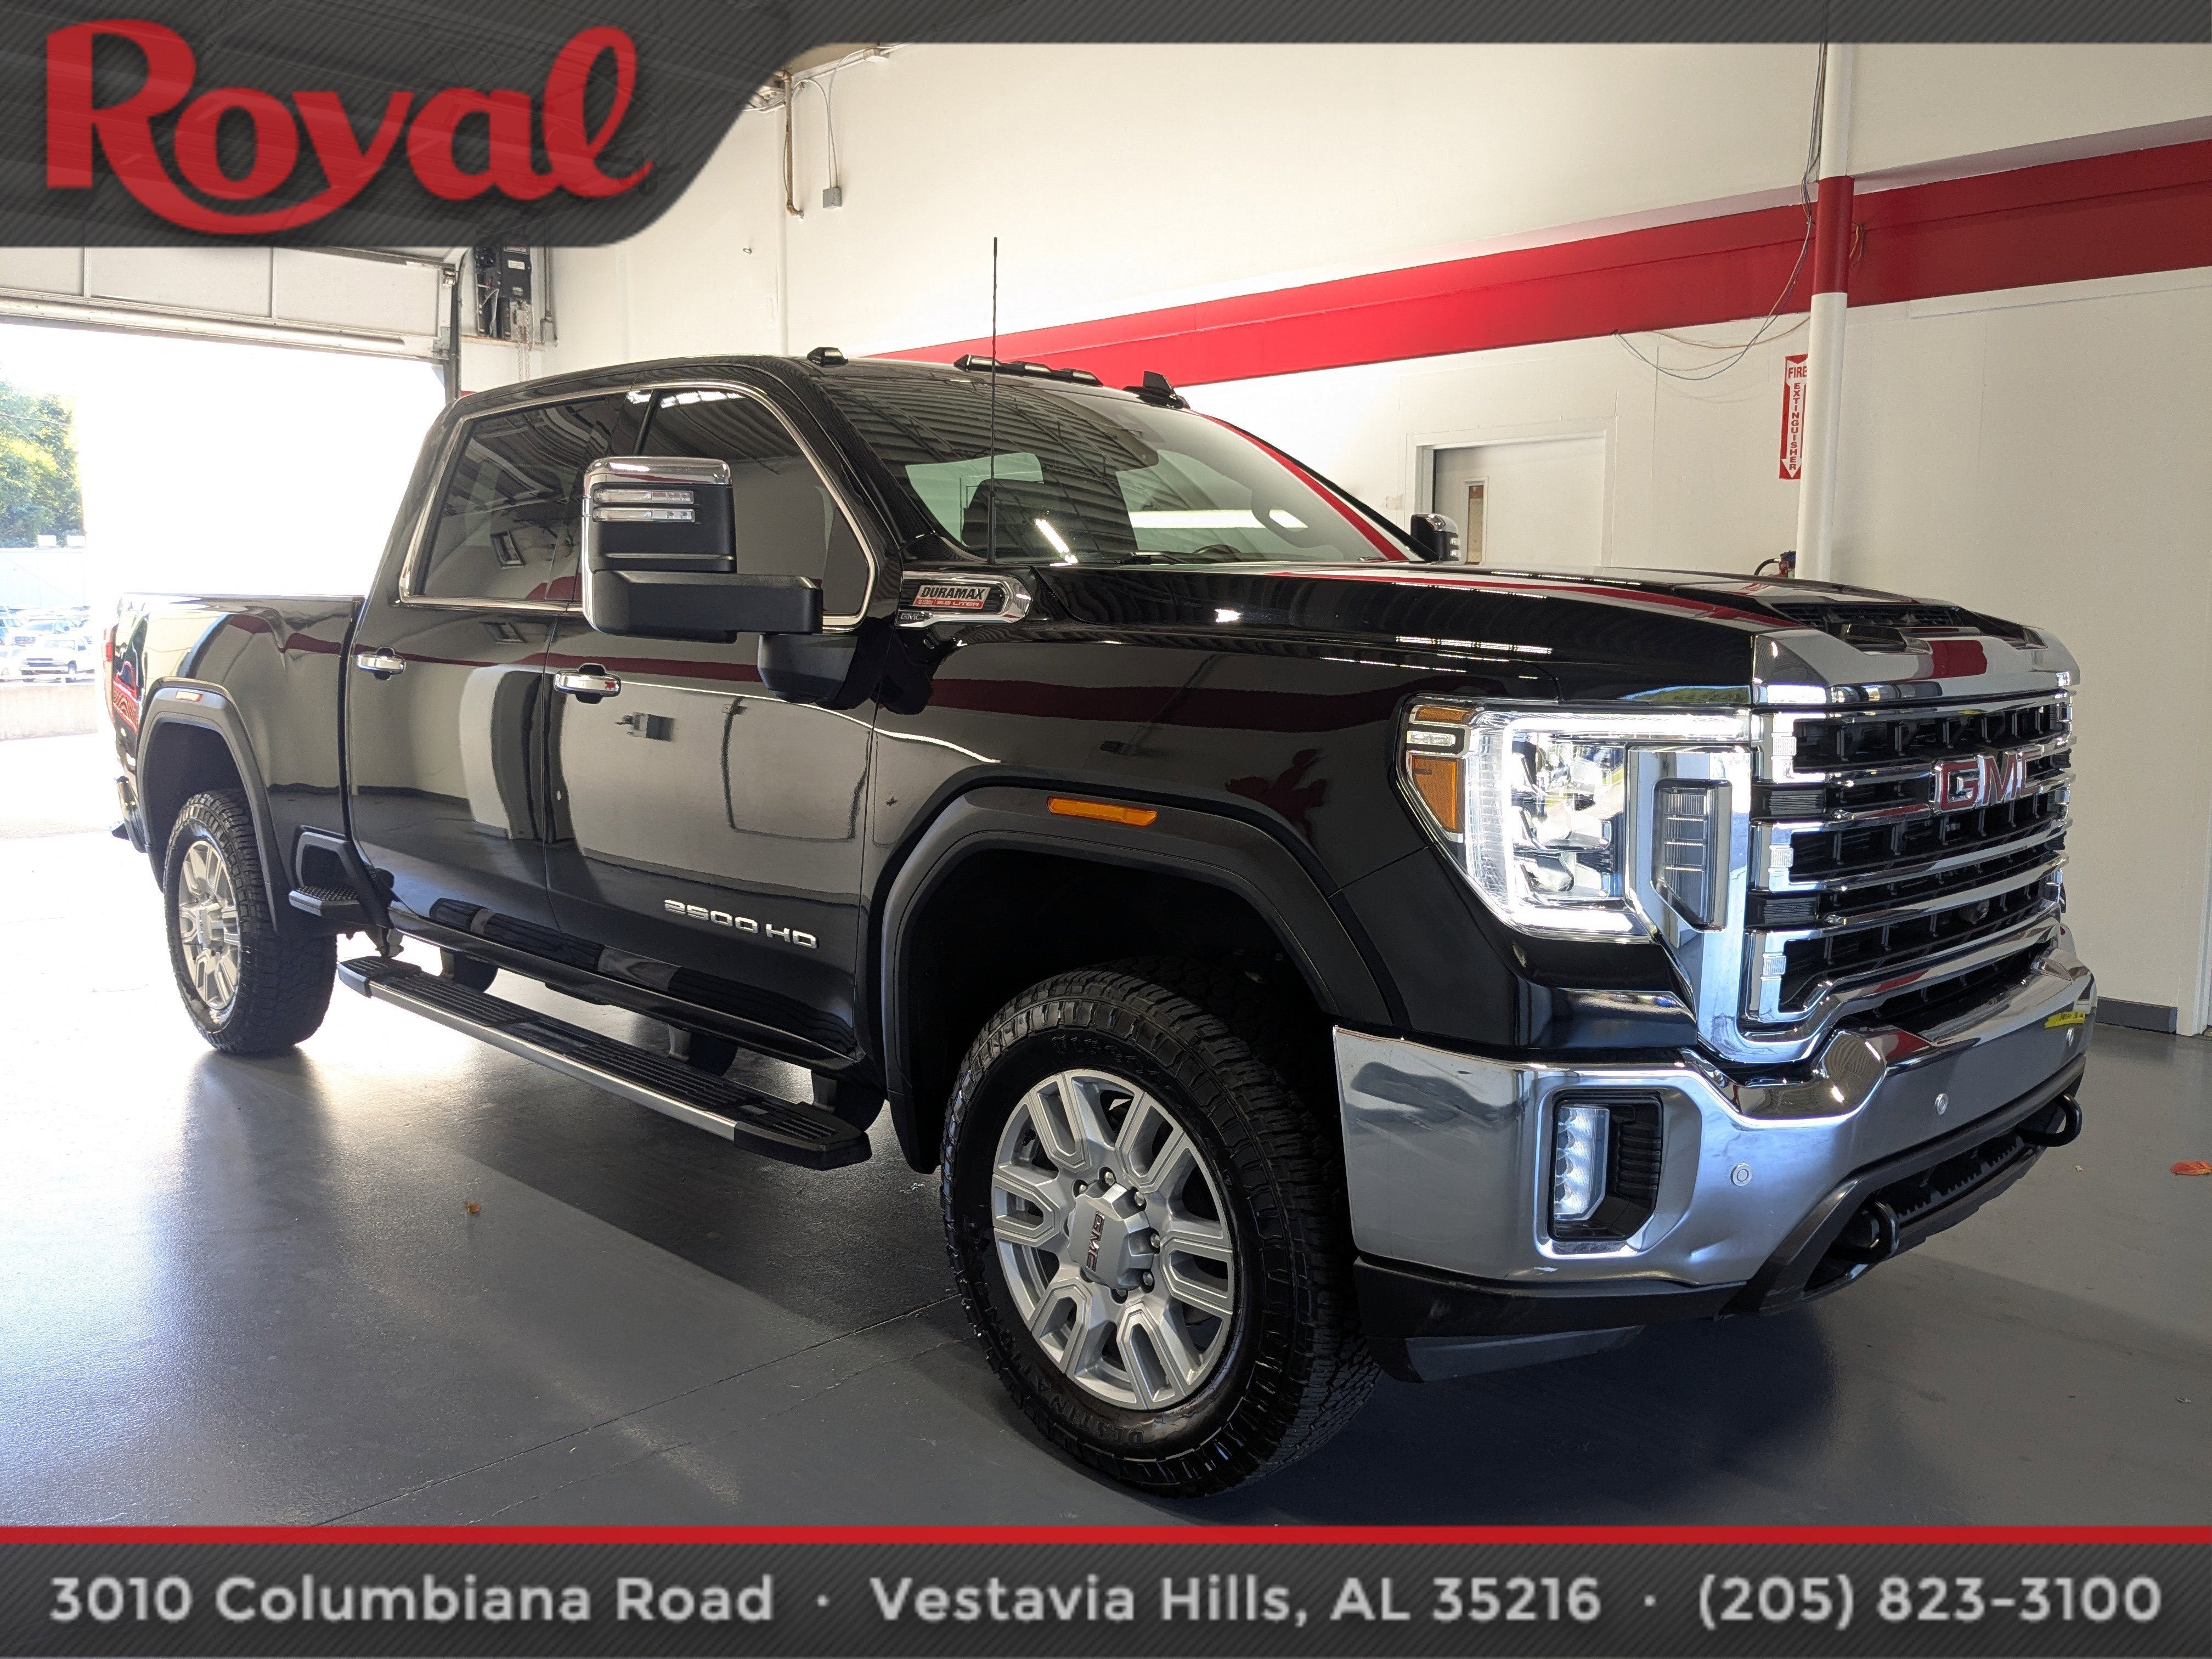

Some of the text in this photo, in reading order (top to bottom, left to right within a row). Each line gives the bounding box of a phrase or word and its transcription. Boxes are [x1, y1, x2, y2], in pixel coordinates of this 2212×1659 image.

[1788, 366, 1807, 379] FIRE
[1789, 382, 1801, 470] EXTINGUISHER
[921, 586, 986, 600] DURAMAX
[1929, 748, 2043, 814] GMC
[664, 899, 818, 949] 2500 HD
[1086, 1210, 1105, 1273] GMC
